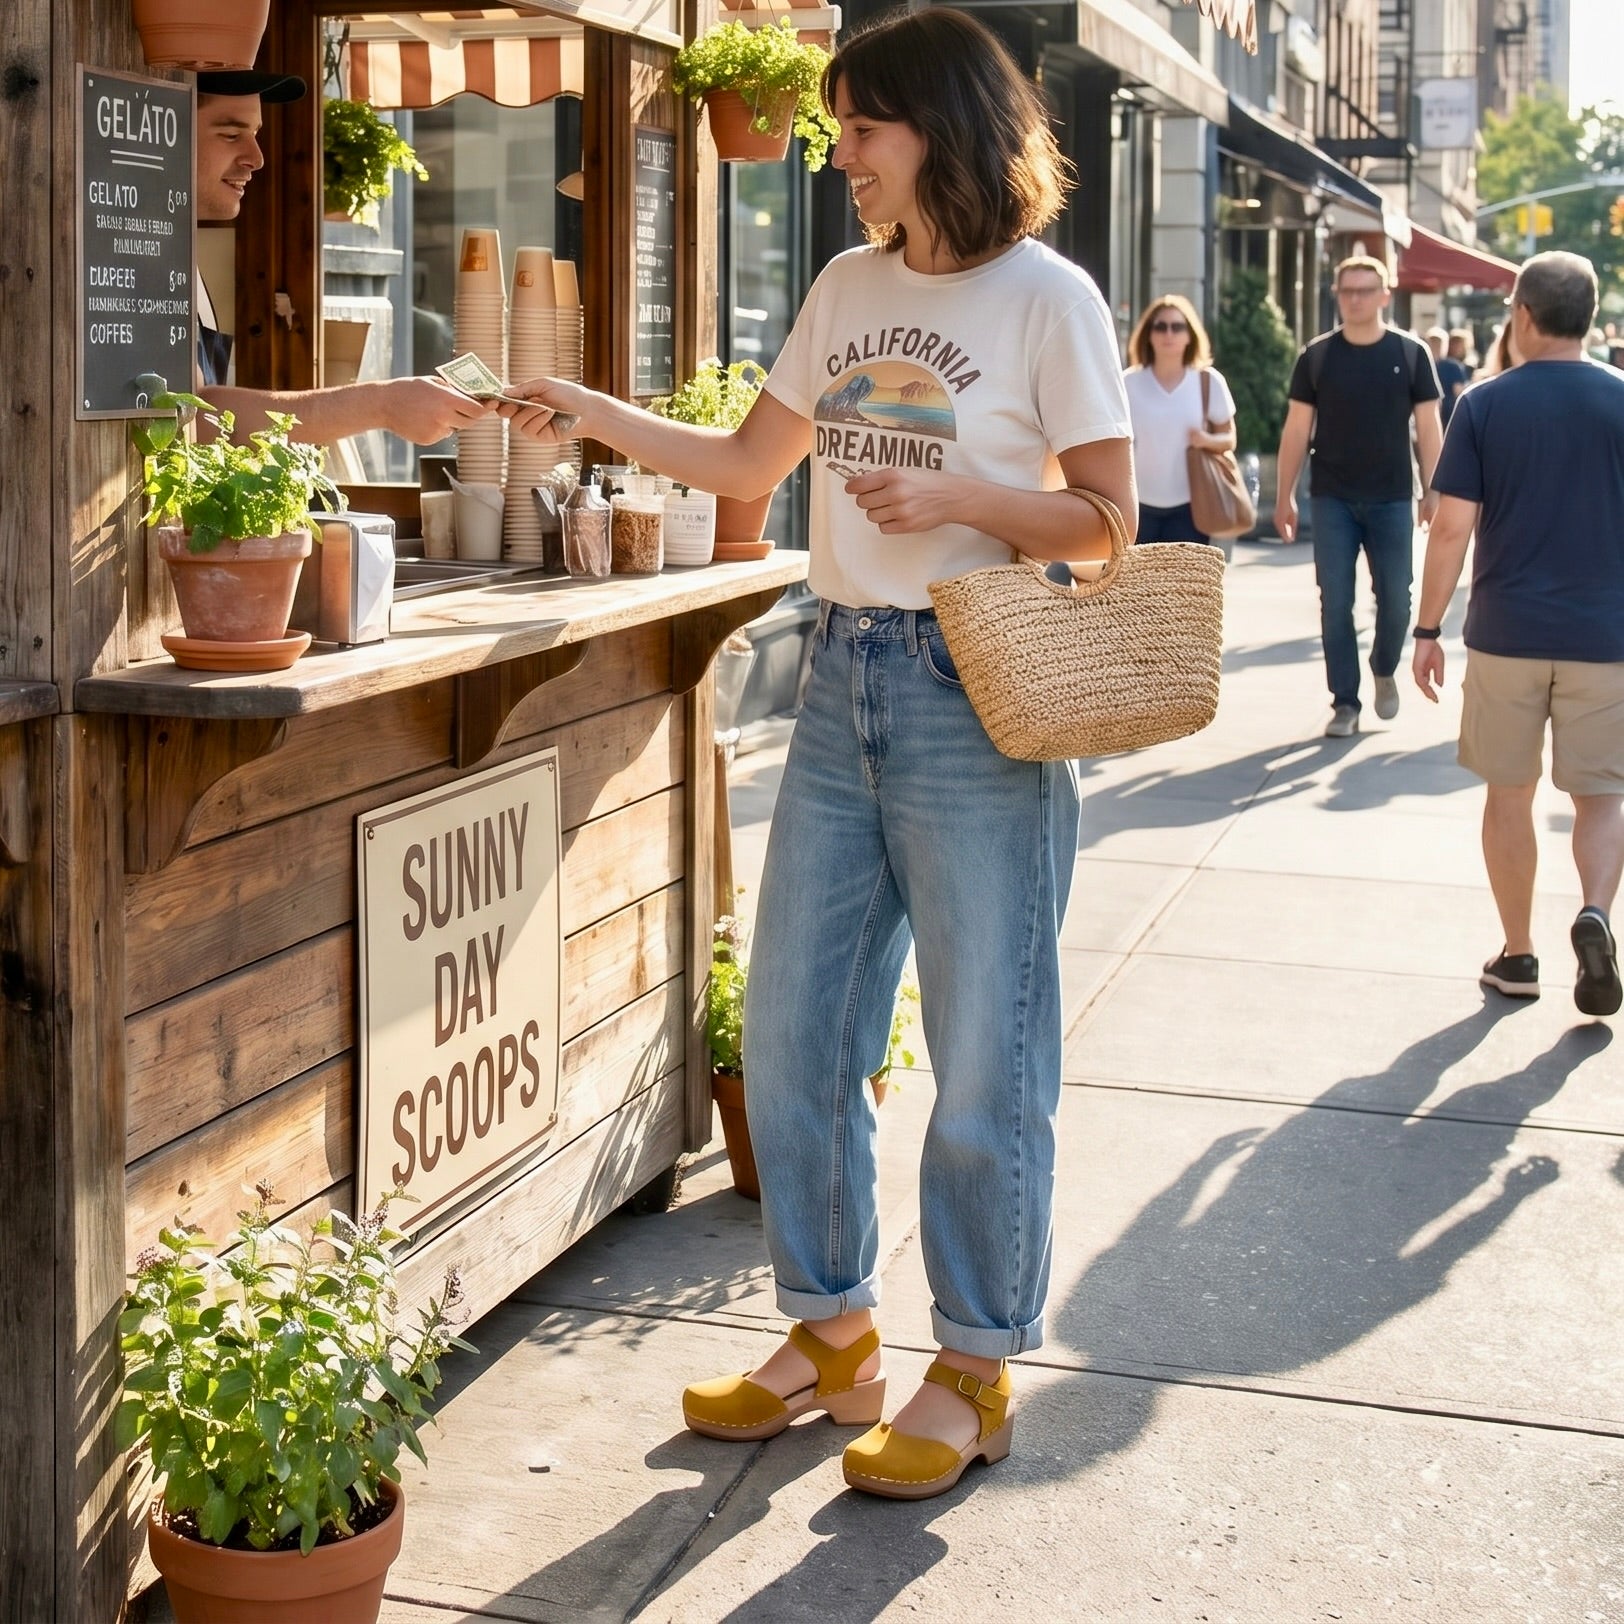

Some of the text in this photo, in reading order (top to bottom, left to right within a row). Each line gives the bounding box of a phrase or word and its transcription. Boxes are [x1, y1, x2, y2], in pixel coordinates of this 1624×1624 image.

[89, 181, 138, 208] GELATO
[826, 327, 982, 395] CALIFORNIA
[816, 425, 944, 471] DREAMING
[402, 801, 529, 942] SUNNY
[435, 924, 505, 1048] DAY
[392, 1019, 540, 1187] SCOOPS
